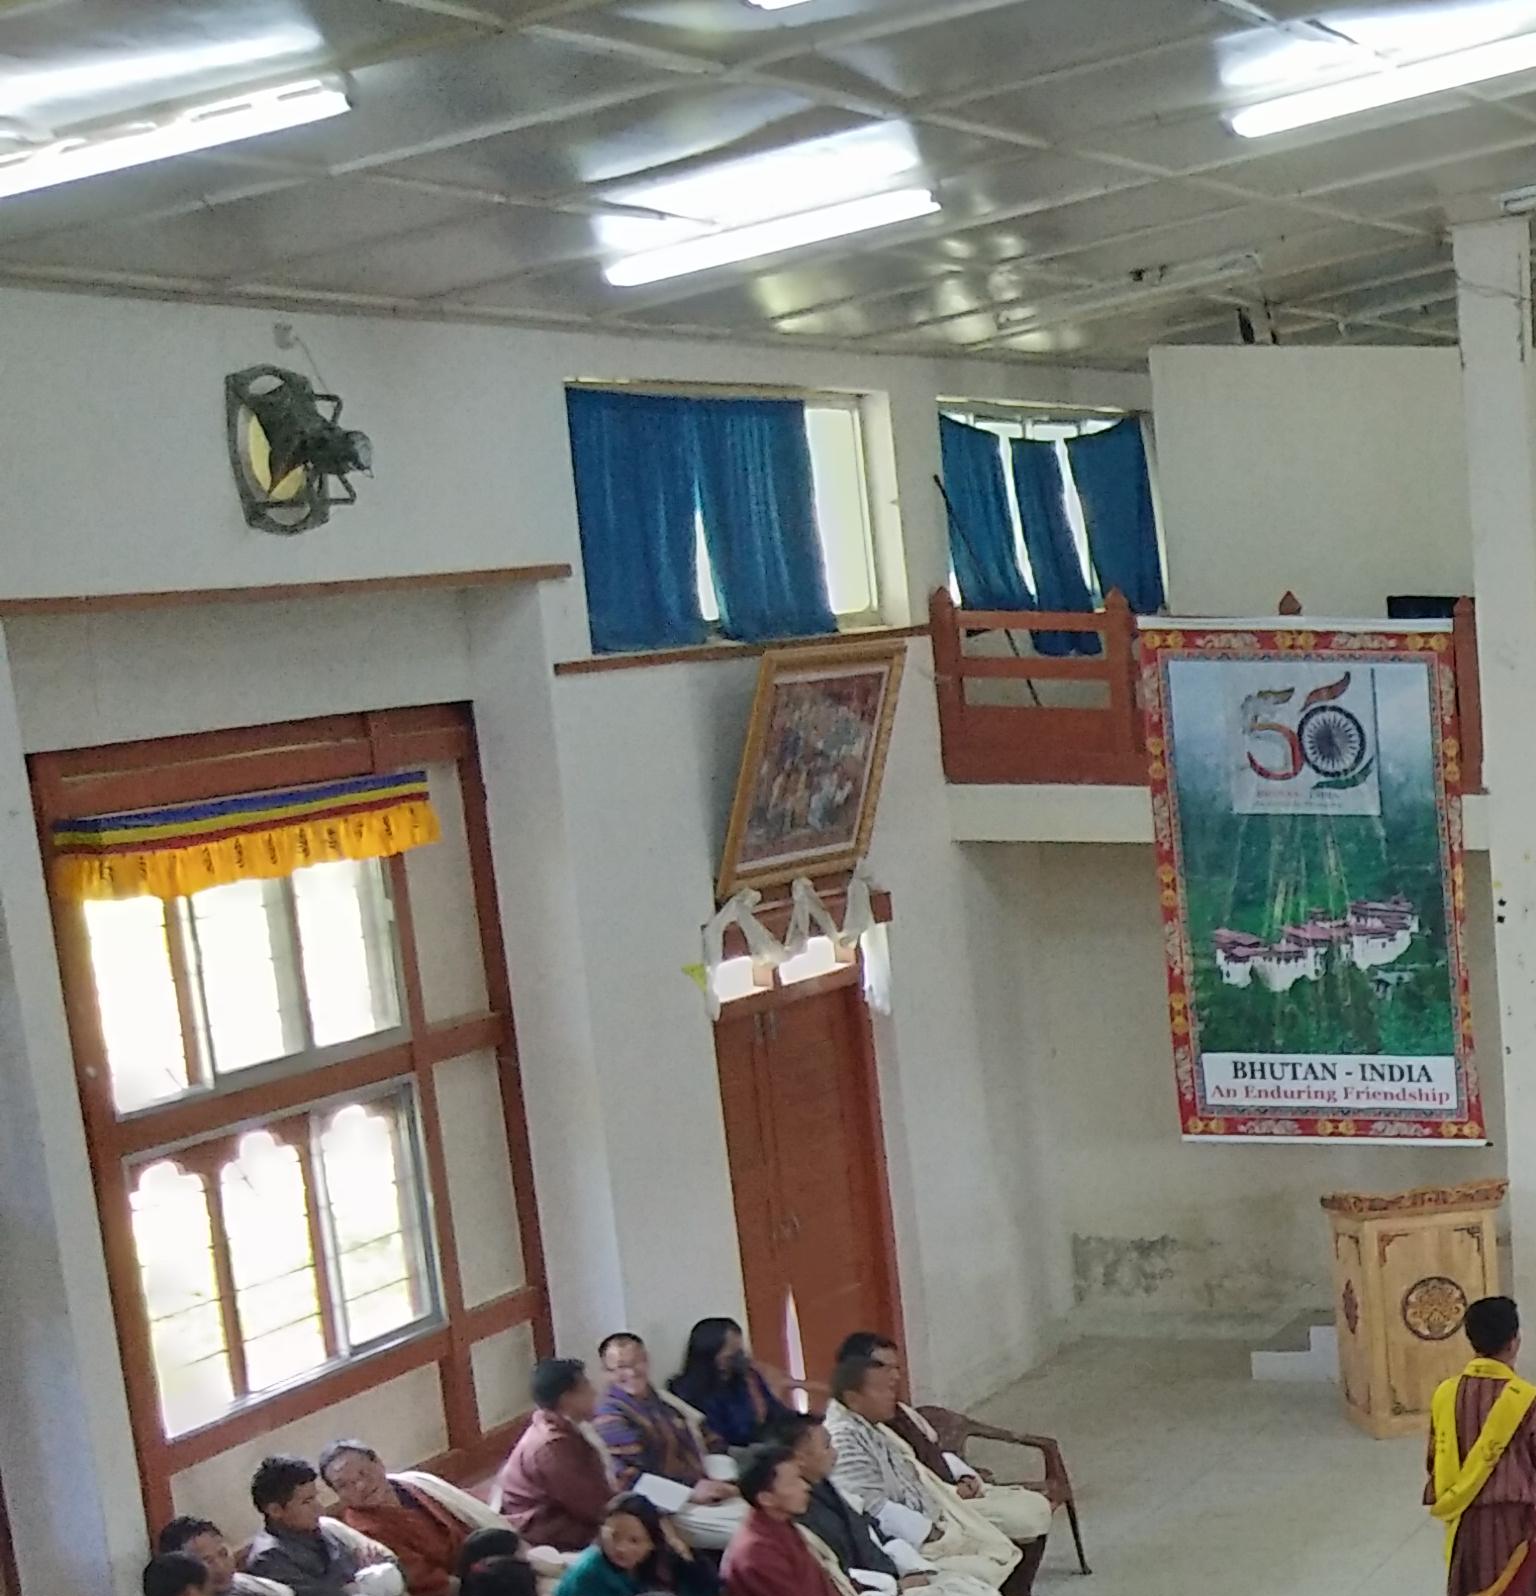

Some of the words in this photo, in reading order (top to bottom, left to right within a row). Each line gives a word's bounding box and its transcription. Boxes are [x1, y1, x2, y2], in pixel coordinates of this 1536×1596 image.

[1231, 1060, 1338, 1081] BHUTAN
[1359, 1063, 1433, 1083] INDIA
[1211, 1085, 1238, 1099] An
[1244, 1085, 1338, 1103] Enduring
[1343, 1086, 1451, 1105] Friendship
